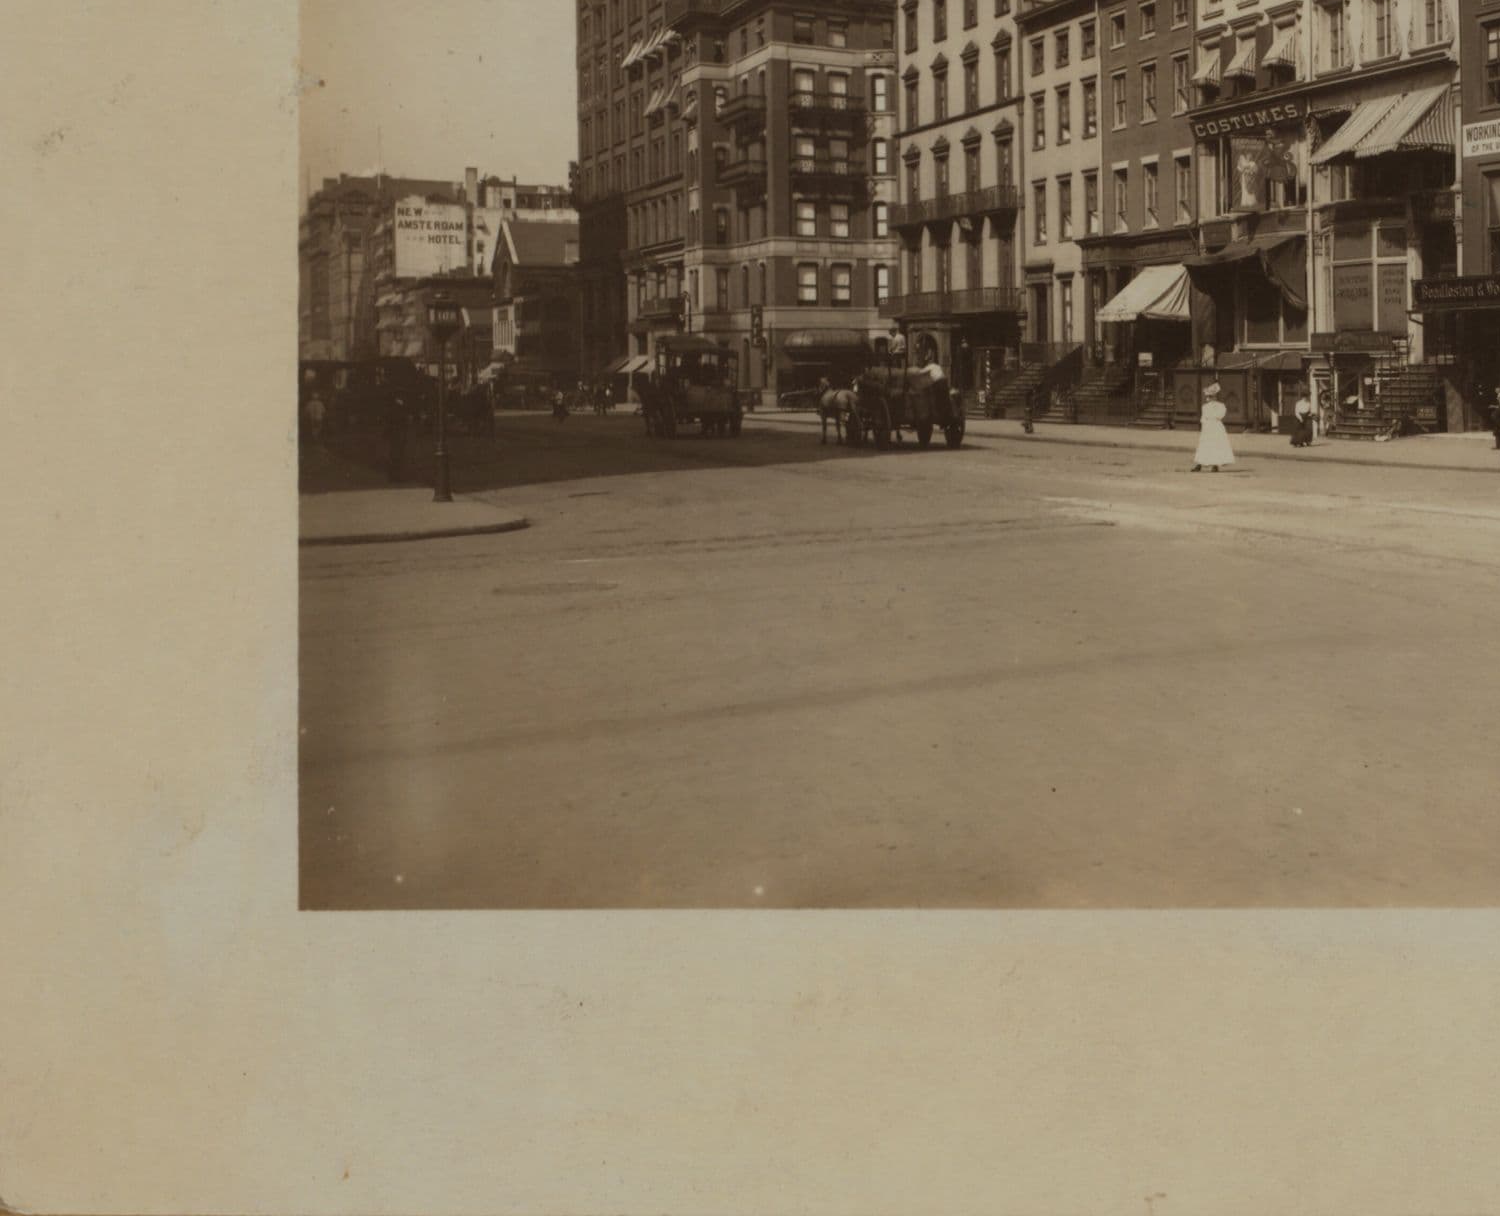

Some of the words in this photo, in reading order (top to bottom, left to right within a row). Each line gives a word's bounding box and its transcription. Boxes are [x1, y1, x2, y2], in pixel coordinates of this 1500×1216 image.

[1471, 145, 1480, 153] OF
[1481, 142, 1494, 152] THE
[397, 208, 423, 216] NEW
[398, 220, 464, 231] AMSTERDAM
[428, 235, 461, 245] HOTEL
